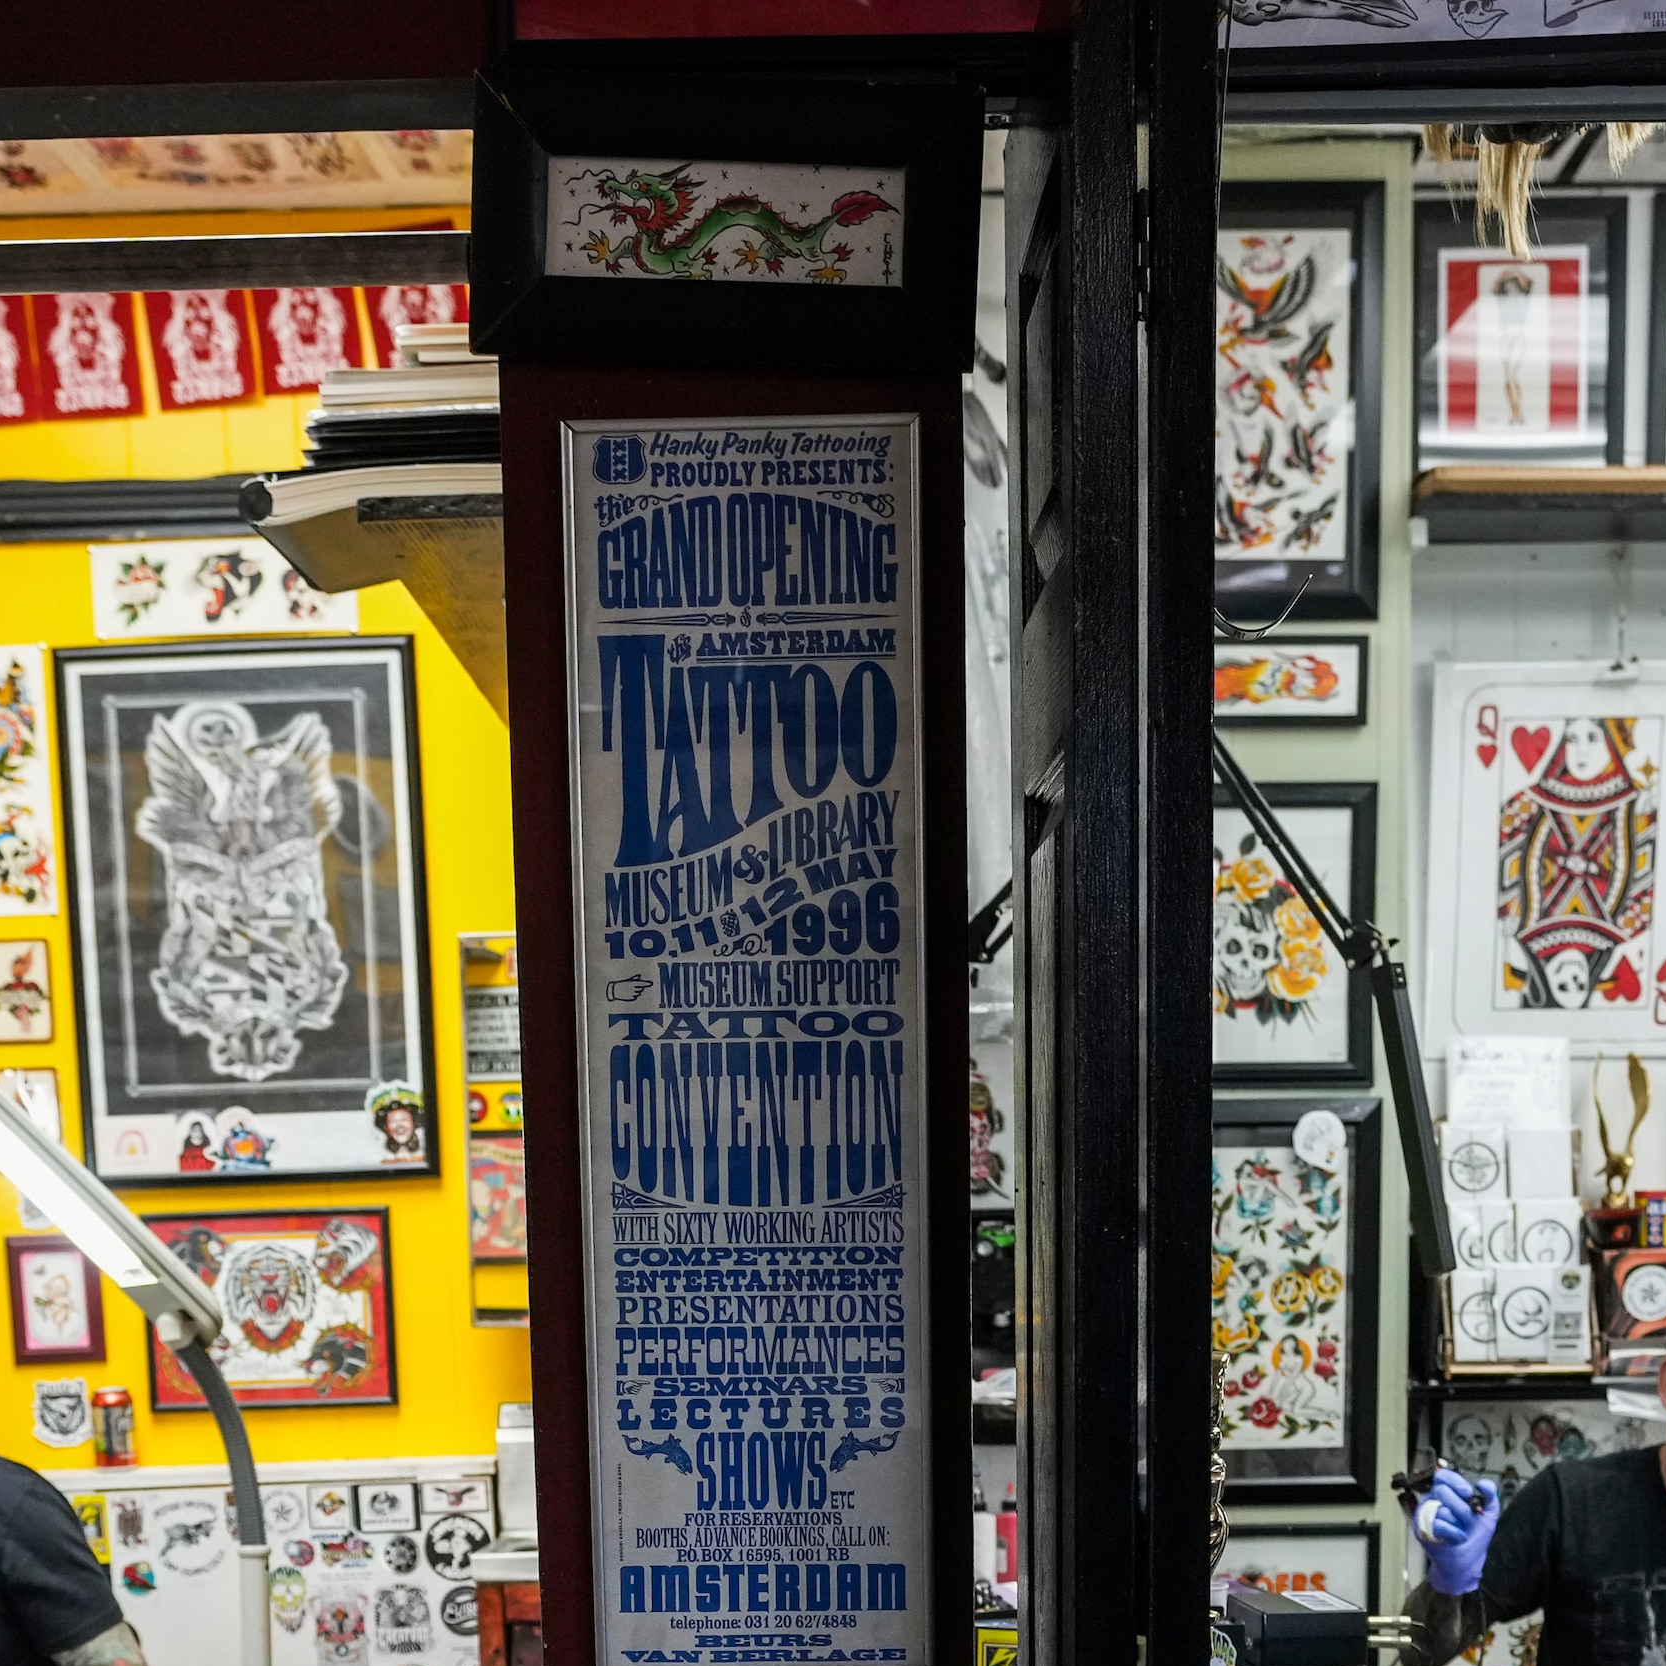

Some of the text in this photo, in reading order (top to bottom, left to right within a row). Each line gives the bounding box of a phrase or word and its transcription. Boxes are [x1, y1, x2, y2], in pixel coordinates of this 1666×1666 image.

[650, 430, 892, 459] Hanky Panky Tattooing
[651, 458, 894, 488] PROUDLY PRESENTS:
[597, 492, 898, 609] GRAND OPENING
[696, 628, 897, 657] AMSTERDAM
[1477, 705, 1499, 740] Q
[597, 634, 898, 868] TATTOO
[604, 790, 899, 928] MUSEUM & LIBRARY
[739, 877, 805, 928] 12
[802, 848, 899, 896] MAY
[764, 881, 901, 956] 1996
[658, 957, 900, 1009] MUSEUM SUPPORT
[608, 1010, 904, 1041] TATTOO
[609, 1040, 904, 1208] CONVENTION
[613, 1210, 905, 1245] WITH SIXTY WORKING ARTISTS
[613, 1245, 905, 1267] COMPETITION
[614, 1268, 905, 1293] ENTERTAINMENT
[616, 1294, 906, 1325] PRESENTATIONS
[615, 1325, 906, 1376] PERFORMANCES
[653, 1376, 868, 1397] SEMINARS
[617, 1396, 906, 1430] LECTURES
[696, 1431, 828, 1512] SHOWS
[830, 1491, 855, 1510] ETC
[684, 1511, 843, 1527] FOR RESERVATIONS
[636, 1527, 693, 1550] BOOTHS,
[694, 1527, 757, 1548] ADVANCE
[760, 1526, 829, 1549] BOOKINGS,
[832, 1526, 866, 1547] CALL
[868, 1525, 890, 1546] ON:
[702, 1549, 734, 1562] BOX
[738, 1549, 785, 1563] 16595,
[790, 1548, 821, 1562] 1001
[827, 1548, 850, 1561] RB
[619, 1563, 907, 1613] AMSTERDAM
[670, 1615, 857, 1632] telephone: 031 20 6274848
[621, 1648, 907, 1663] VAN BERLAGE
[695, 1634, 833, 1648] BEURS
